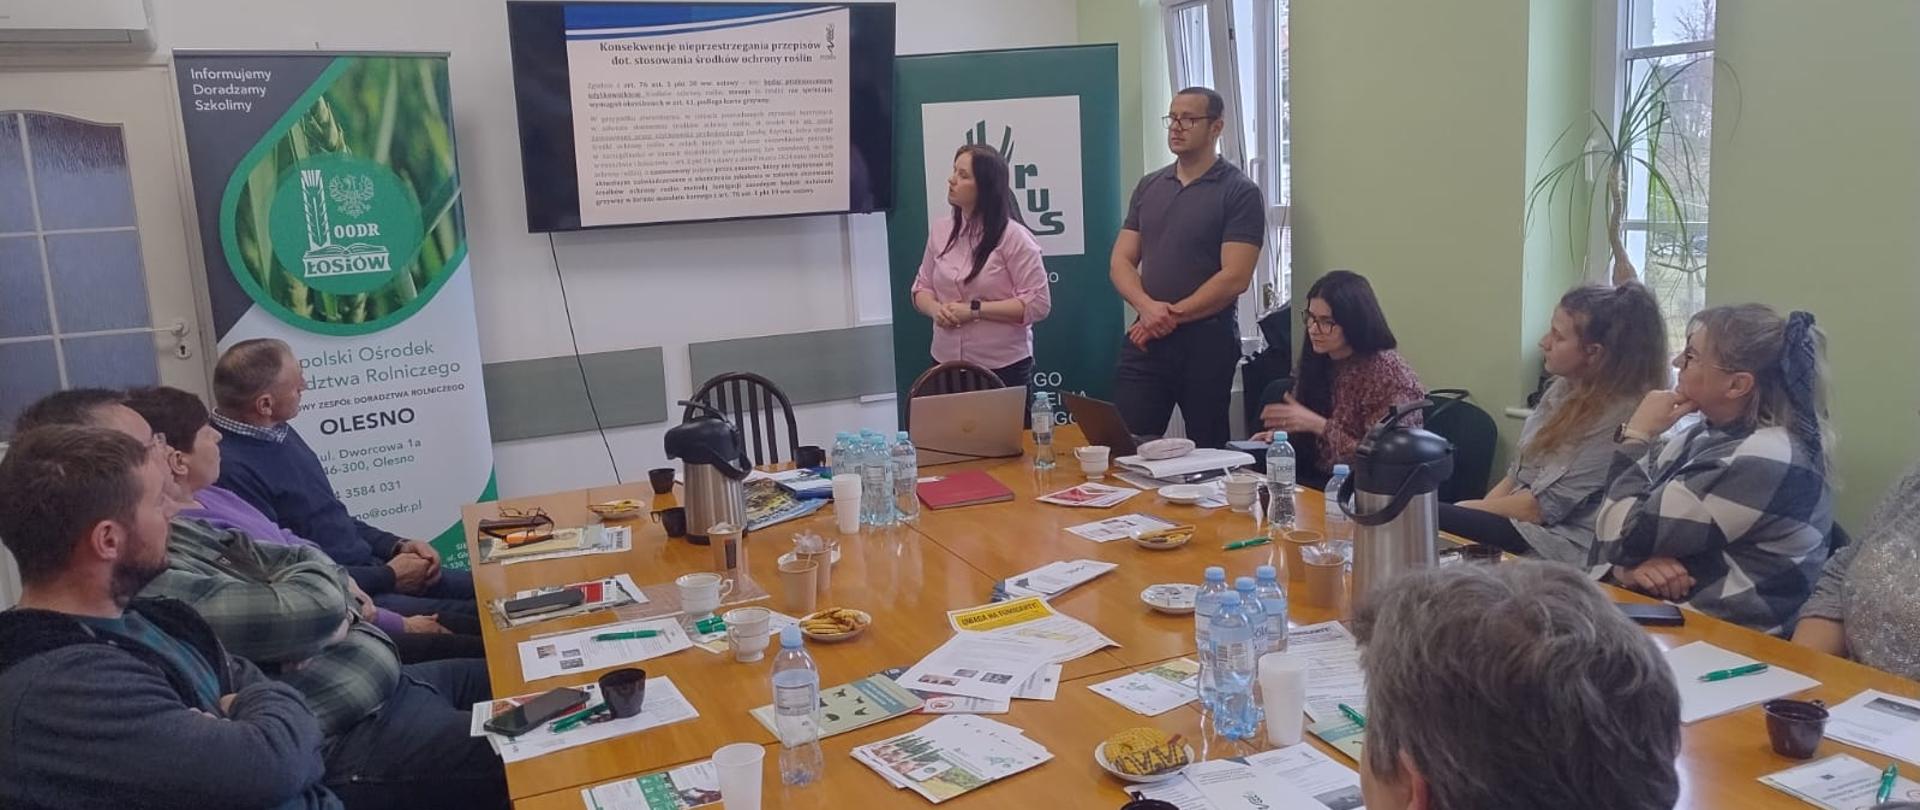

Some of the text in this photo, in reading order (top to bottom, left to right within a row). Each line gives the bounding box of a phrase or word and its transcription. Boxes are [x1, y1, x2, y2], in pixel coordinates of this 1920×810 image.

[599, 41, 821, 53] Konsekwencje nieprzestrzegania przepisów
[611, 56, 631, 66] dot.
[634, 56, 693, 65] stosowania
[695, 53, 739, 64] środków
[741, 54, 782, 65] ochrony
[784, 53, 813, 63] roślin
[190, 68, 272, 82] Informujemy
[193, 84, 267, 97] Doradzamy
[195, 99, 252, 112] Szkolimy
[334, 223, 381, 239] OODR
[299, 340, 435, 369] polski Ośrodek
[306, 362, 461, 391] dztwa Rolniczego
[354, 391, 409, 405] DORADZTWA
[411, 383, 465, 397] ROLNICZEGO
[320, 408, 415, 435] OLESNO
[320, 438, 422, 462] ul. Dworcowa 1a
[372, 454, 415, 468] Olesno
[344, 485, 376, 499] 3584
[379, 480, 401, 493] 031
[355, 499, 422, 520] no@oodr.pl
